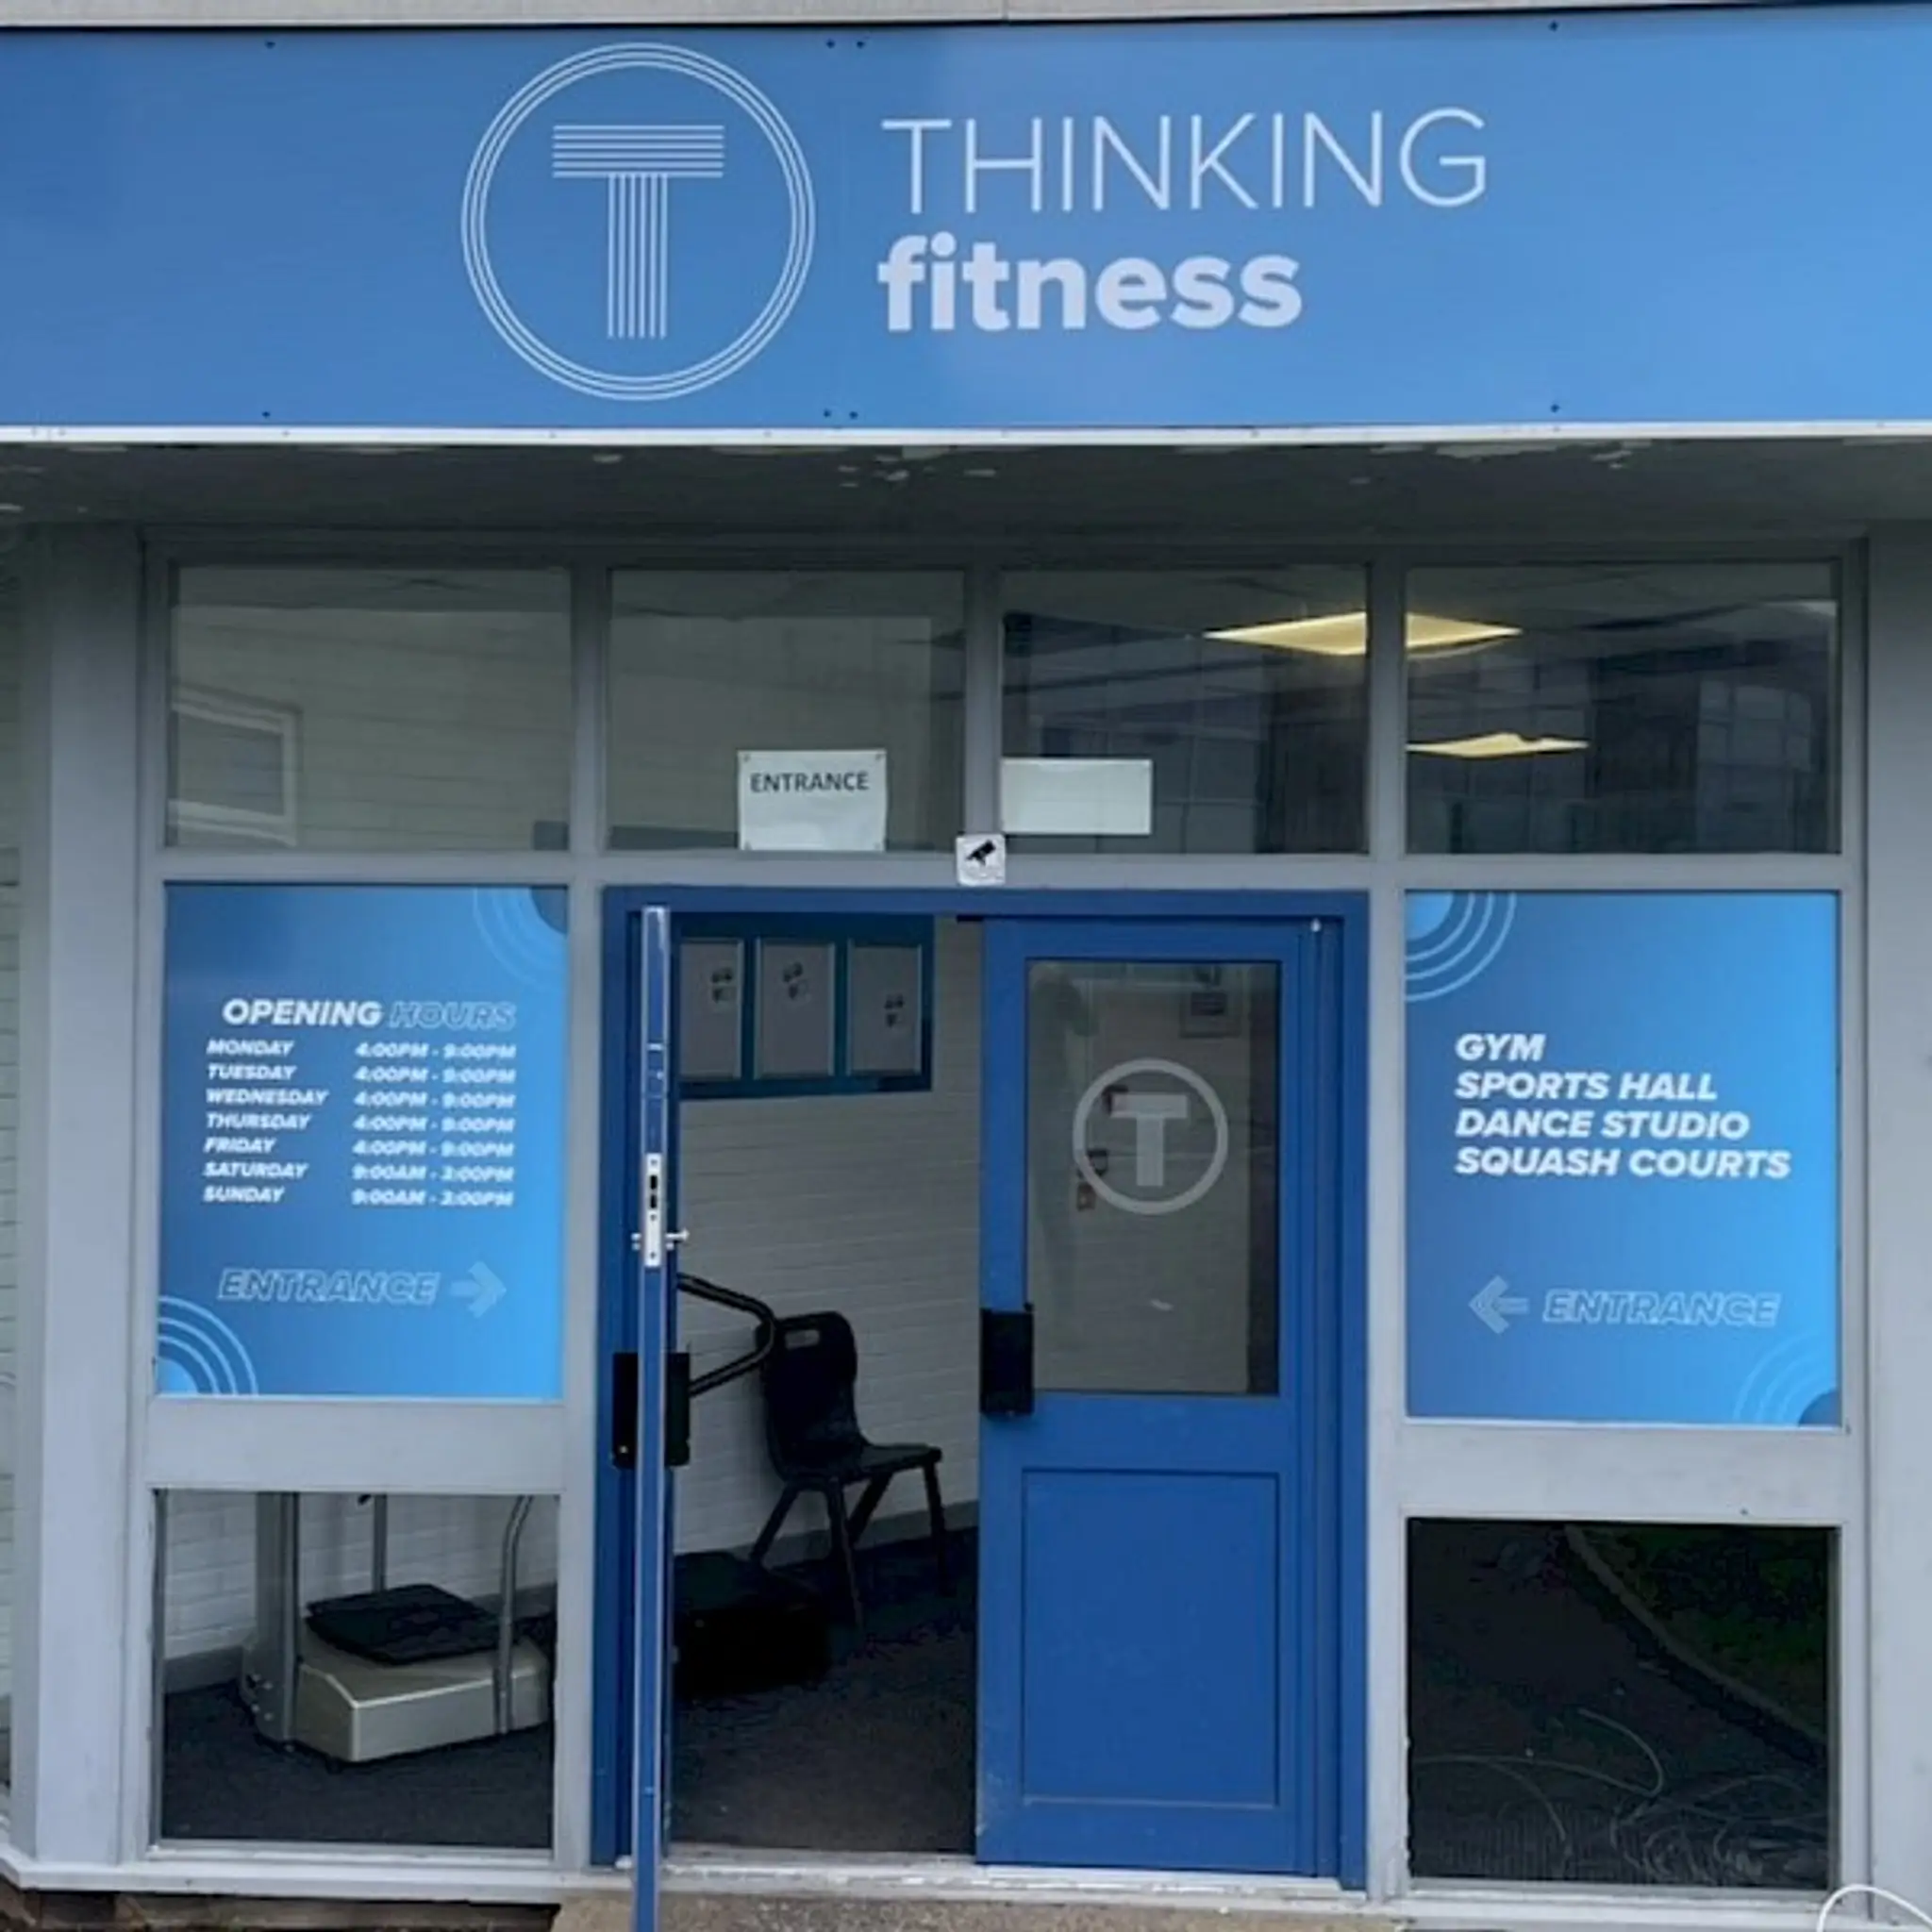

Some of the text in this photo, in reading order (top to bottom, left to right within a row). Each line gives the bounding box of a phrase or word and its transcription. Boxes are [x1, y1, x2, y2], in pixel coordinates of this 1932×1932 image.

[882, 107, 1488, 214] THINKING
[878, 231, 1303, 333] fitness
[750, 771, 870, 793] ENTRANCE
[222, 997, 517, 1031] OPENING HOURS
[206, 1039, 294, 1058] MONDAY
[355, 1041, 430, 1058] 4:00PM
[1455, 1034, 1545, 1062] GYM
[208, 1063, 297, 1080] TUESDAY
[353, 1065, 429, 1083] 4:00PM
[1455, 1072, 1718, 1101] SPORTS HALL
[206, 1088, 329, 1106] WEDNESDAY
[353, 1091, 429, 1108] 4:00PM
[206, 1112, 311, 1130] THURSDAY
[352, 1114, 429, 1132] 4:00PM
[1455, 1109, 1750, 1140] DANCE STUDIO
[203, 1137, 276, 1154] FRIDAY
[351, 1140, 427, 1157] 4:00PM
[203, 1161, 309, 1178] SATURDAY
[1455, 1148, 1790, 1179] SQUASH COURTS
[203, 1186, 284, 1203] SUNDAY
[218, 1269, 439, 1305] ENTRANCE
[1542, 1290, 1780, 1328] ENTRANCE
